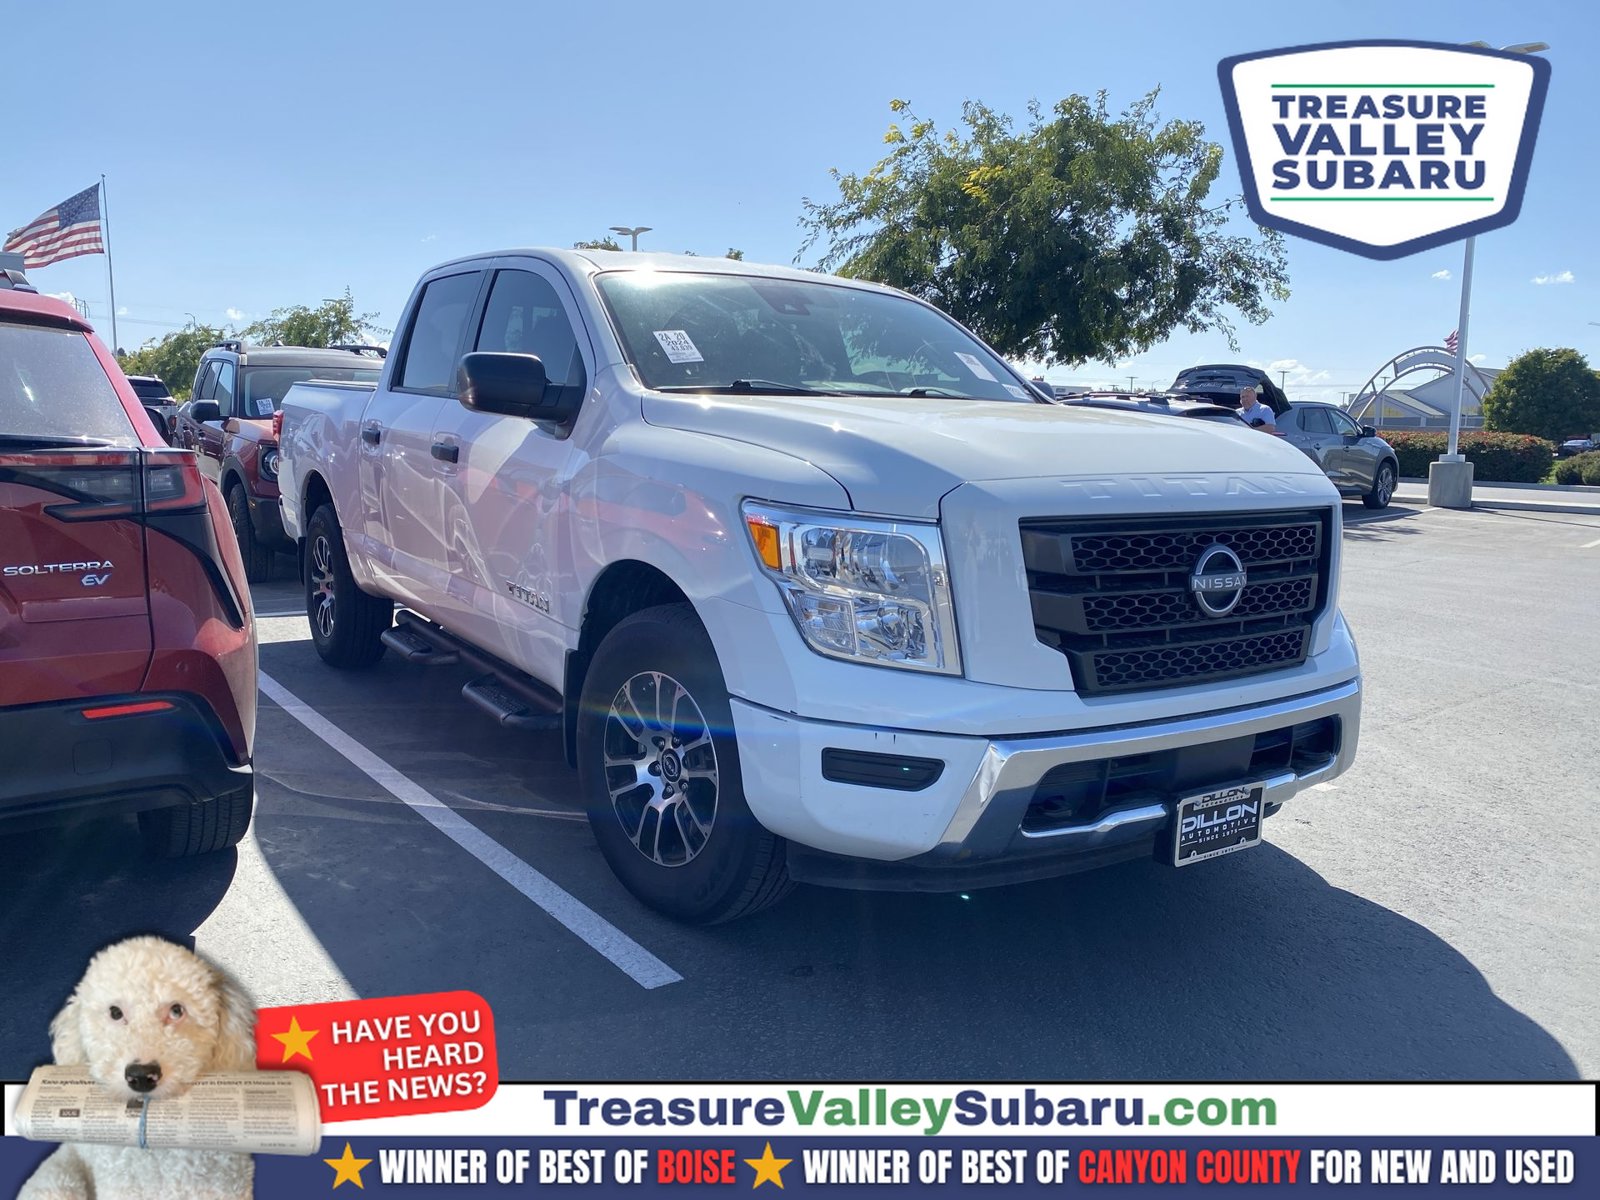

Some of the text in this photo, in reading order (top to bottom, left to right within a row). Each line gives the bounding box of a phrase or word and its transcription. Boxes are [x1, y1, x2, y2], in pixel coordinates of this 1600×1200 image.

[1060, 475, 1307, 499] TITAN
[3, 560, 115, 576] SOLTERRA
[81, 573, 111, 586] EV
[1193, 575, 1247, 589] NISSAN
[1201, 787, 1247, 803] DILLON
[1181, 801, 1258, 833] DILLON
[1180, 816, 1257, 841] AUTOMOTIVE
[1198, 832, 1219, 844] SINCE
